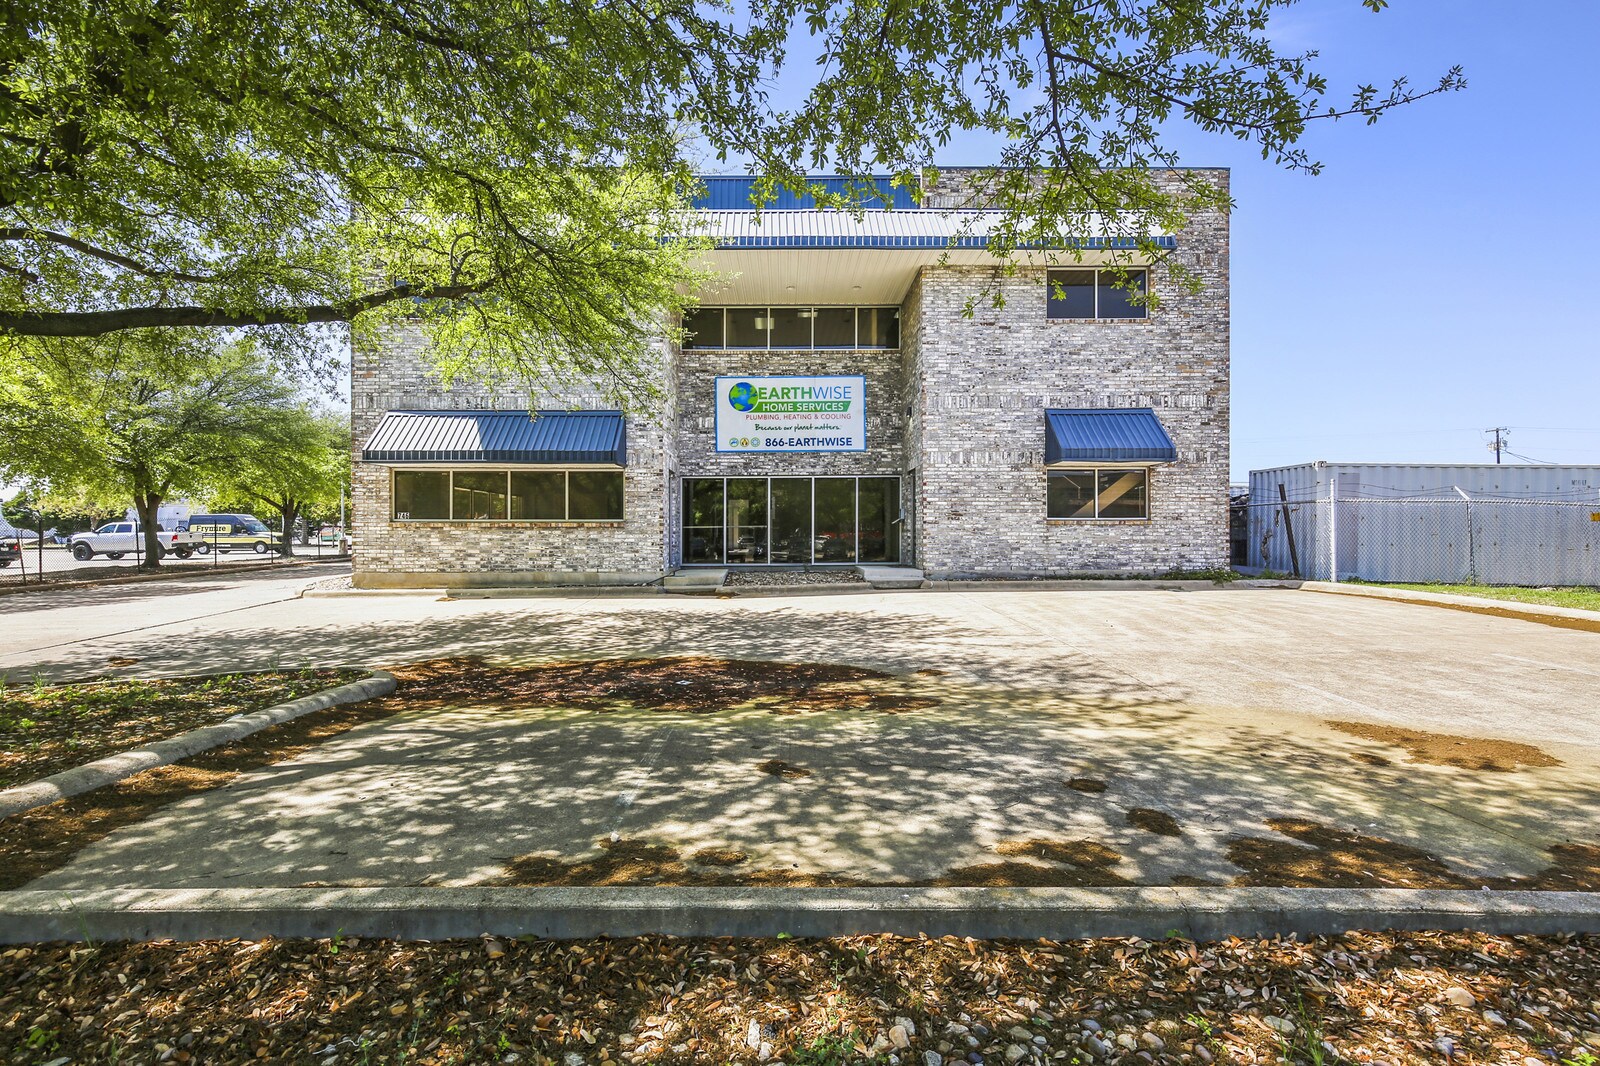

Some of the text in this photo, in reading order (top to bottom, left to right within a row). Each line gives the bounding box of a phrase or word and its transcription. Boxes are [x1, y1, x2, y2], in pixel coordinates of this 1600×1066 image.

[759, 386, 852, 400] EARTHWISE
[762, 402, 844, 412] HOME SERVICES
[755, 423, 783, 431] Because
[794, 424, 813, 432] planet
[765, 437, 852, 447] 866-EARTHWISE
